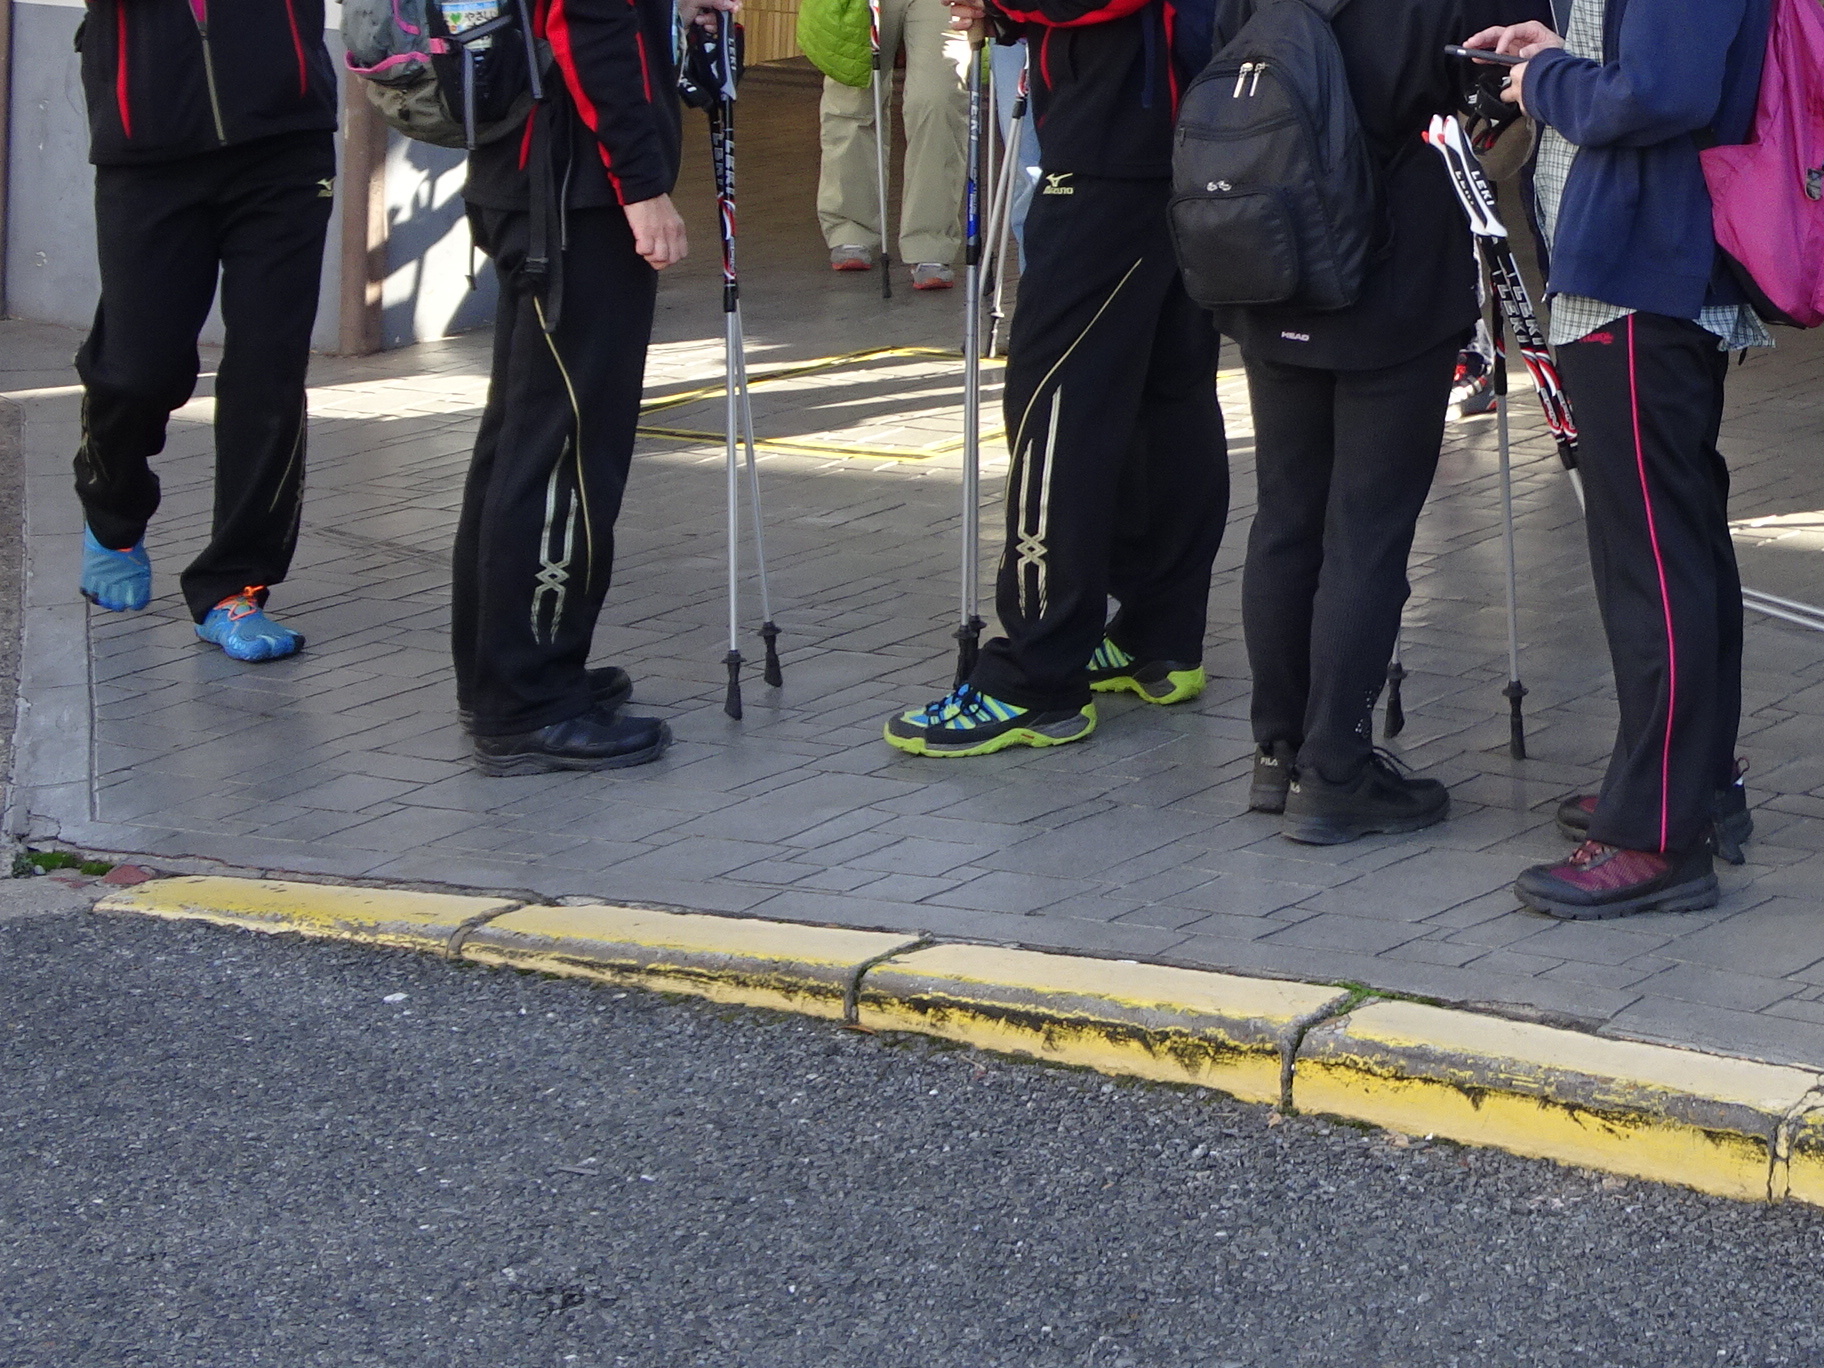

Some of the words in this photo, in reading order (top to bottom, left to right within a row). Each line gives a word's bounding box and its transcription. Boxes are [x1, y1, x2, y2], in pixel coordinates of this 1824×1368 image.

[728, 37, 737, 72] LEKI
[970, 91, 979, 141] LEKI
[1471, 170, 1495, 206] LEKI
[1497, 284, 1530, 343] LEKI
[1512, 285, 1545, 345] LEKI
[1281, 331, 1310, 342] HEAD
[1260, 757, 1279, 767] FILA
